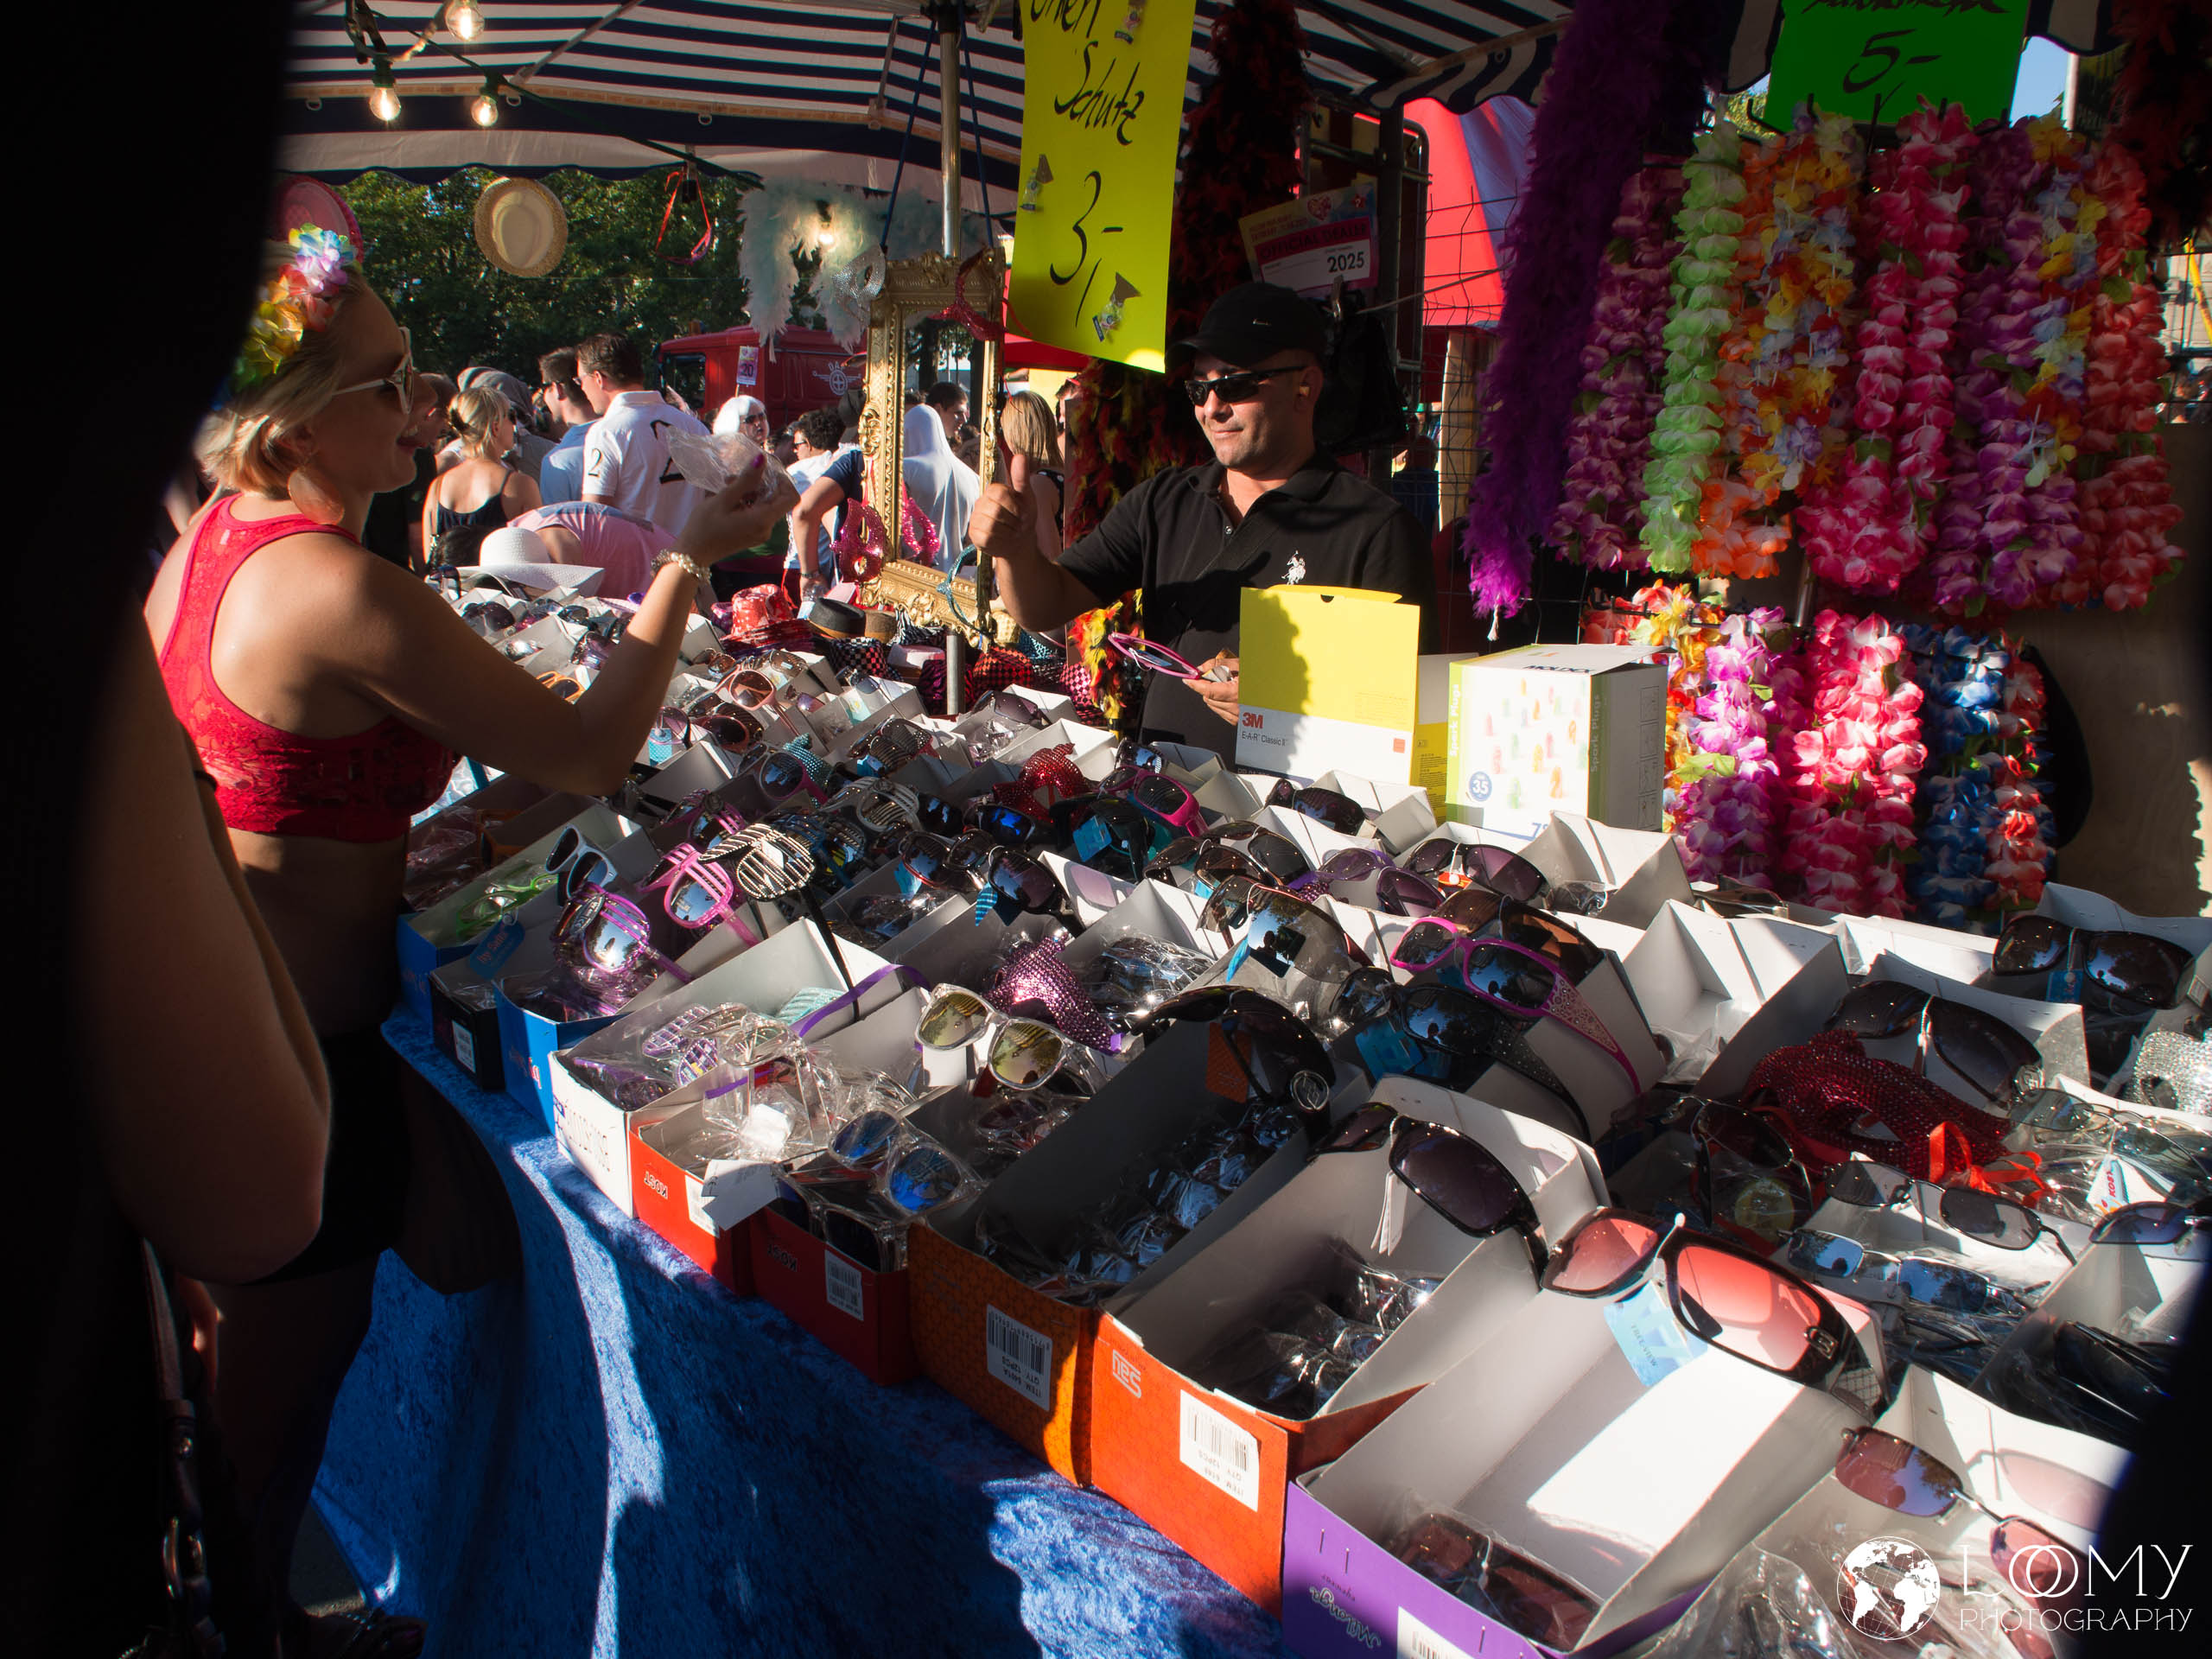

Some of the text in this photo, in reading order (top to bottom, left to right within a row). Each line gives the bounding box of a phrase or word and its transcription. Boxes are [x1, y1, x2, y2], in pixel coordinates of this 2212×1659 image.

[1054, 41, 1145, 145] Schutz
[1259, 233, 1321, 259] OFFICIAL
[1321, 223, 1367, 243] DEALER
[1326, 251, 1365, 274] 2025
[740, 362, 754, 378] 20
[588, 448, 602, 477] 2
[1242, 711, 1263, 729] 3M
[1449, 683, 1460, 757] Spark Plugs
[1261, 734, 1281, 746] Classic
[1590, 733, 1601, 772] Spark
[1471, 779, 1489, 795] 35
[644, 1171, 668, 1199] KOST
